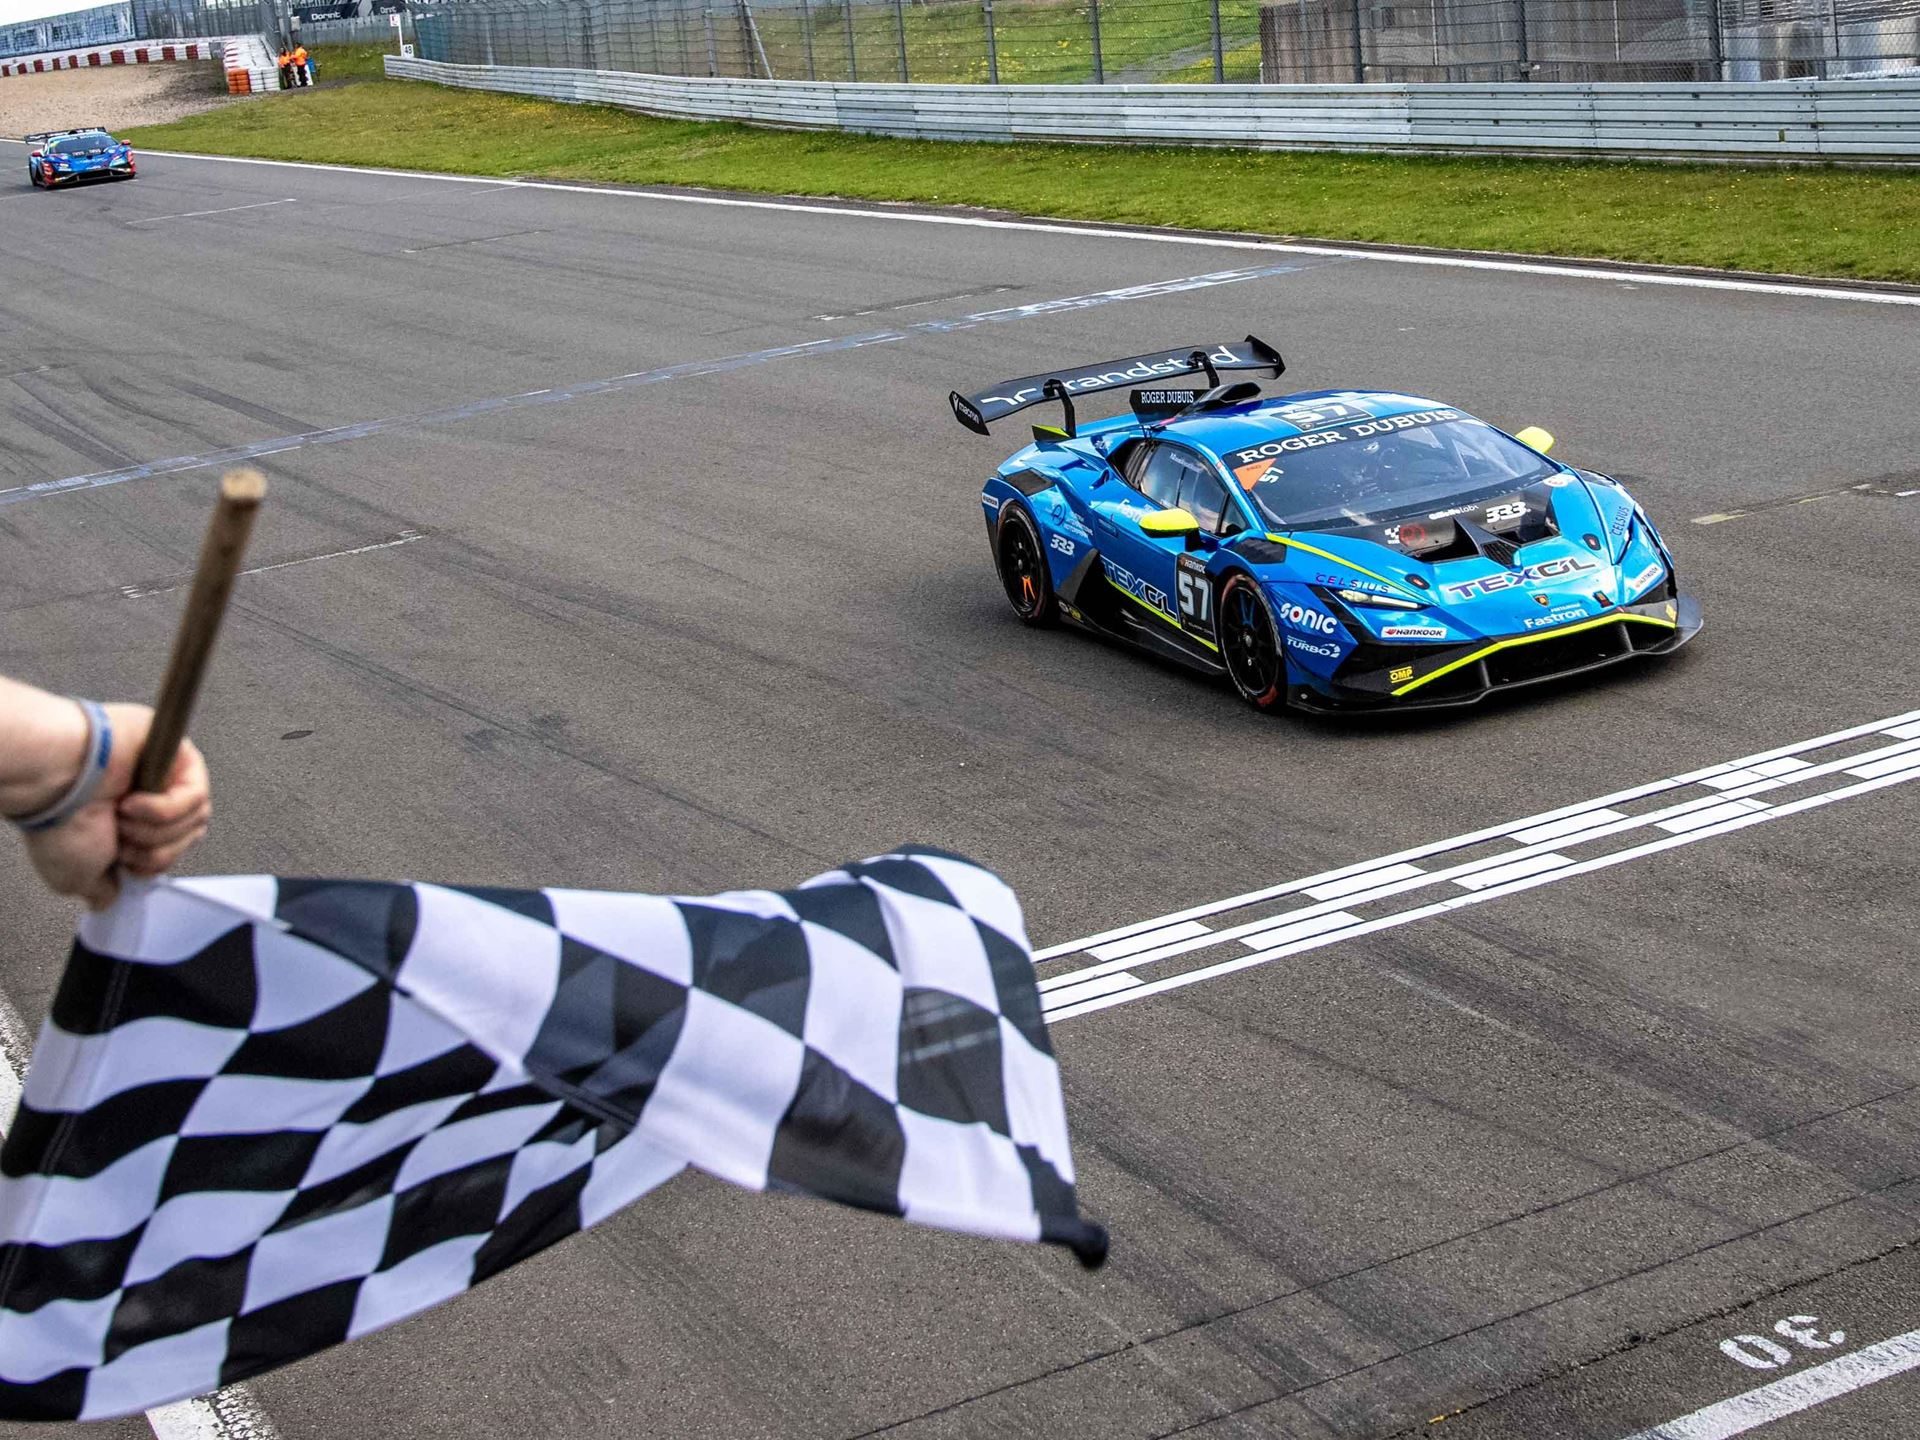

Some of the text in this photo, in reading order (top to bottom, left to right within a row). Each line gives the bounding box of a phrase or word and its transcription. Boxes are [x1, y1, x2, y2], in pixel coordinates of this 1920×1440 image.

[311, 11, 341, 21] Dorint
[1065, 345, 1243, 390] randstd
[1140, 390, 1195, 404] ROGER DUBUIS
[1236, 431, 1348, 463] ROGER
[1350, 410, 1461, 437] DUBUIS
[1050, 533, 1075, 556] 333
[1315, 572, 1390, 594] CELSIUS
[1178, 570, 1209, 621] 57
[1523, 608, 1590, 630] Fastron
[1390, 668, 1413, 681] OMP
